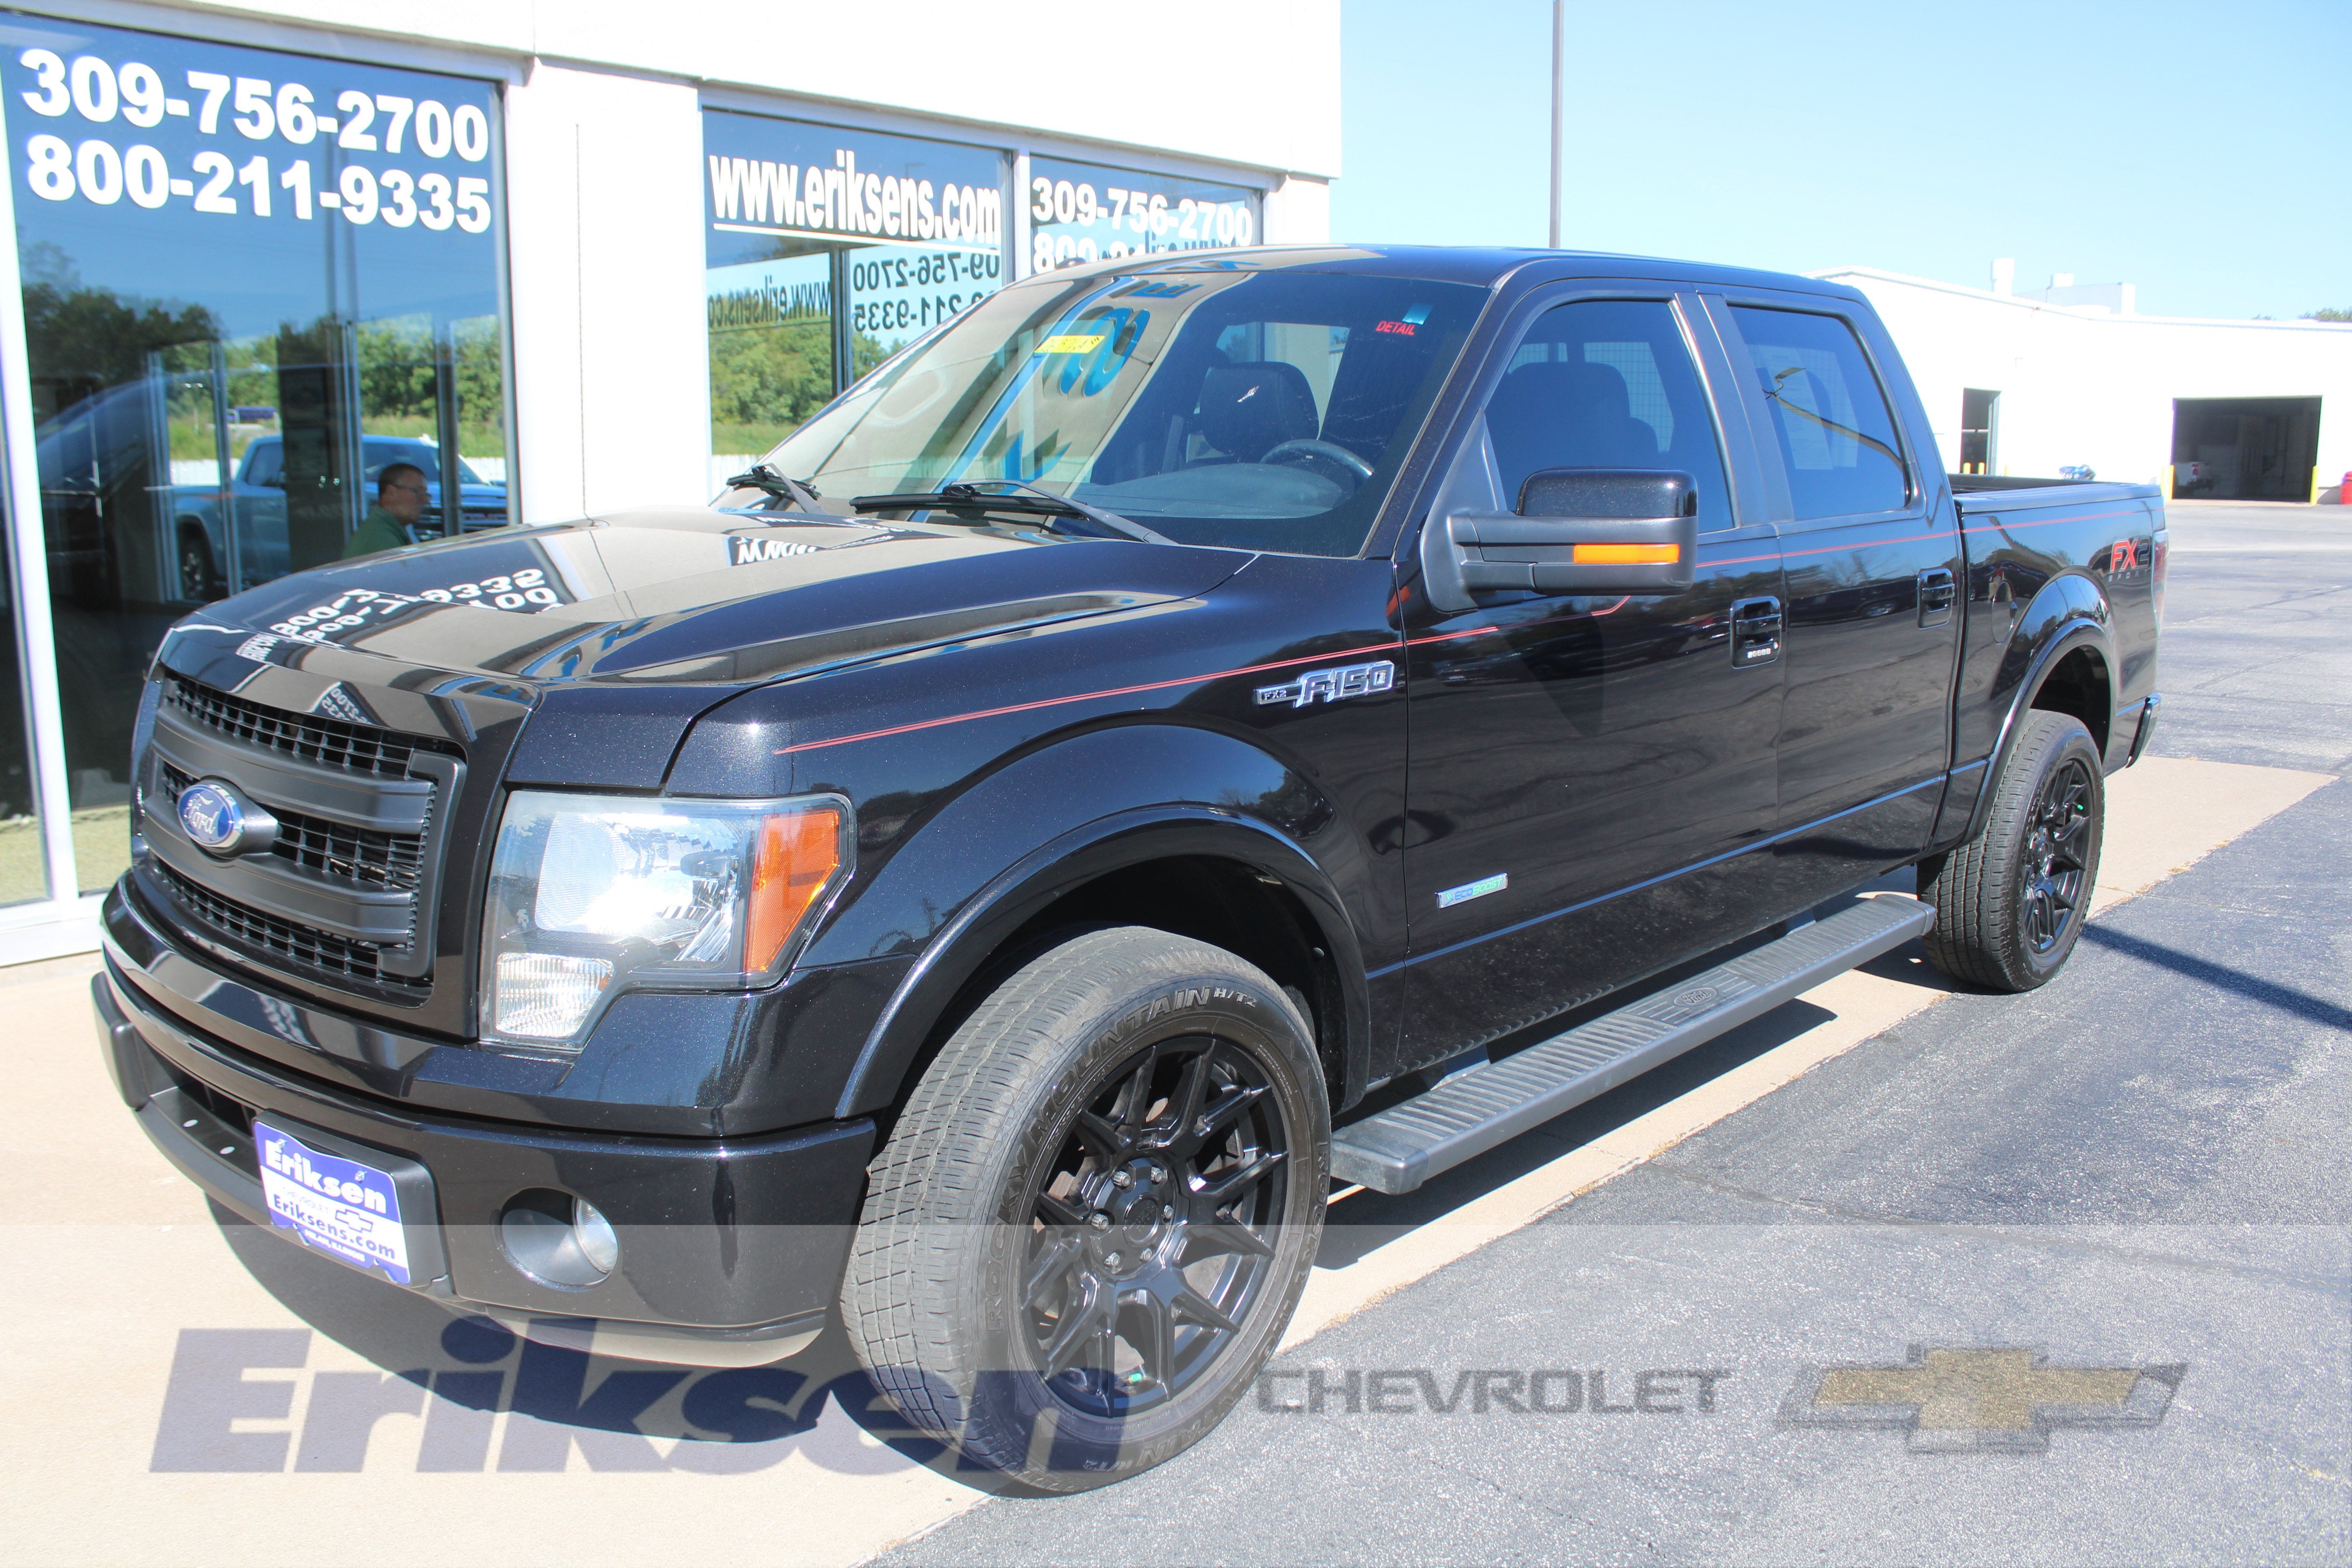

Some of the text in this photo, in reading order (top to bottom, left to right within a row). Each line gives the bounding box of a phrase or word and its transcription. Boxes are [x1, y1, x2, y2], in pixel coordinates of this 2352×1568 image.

[20, 48, 489, 162] 309-756-2700
[27, 134, 492, 234] 800-211-9335
[709, 149, 1001, 245] www.eriksens.com
[1032, 177, 1253, 246] 309-756-2700
[1375, 321, 1416, 335] DETAIL
[2109, 537, 2151, 573] FX2
[1263, 689, 1287, 700] FX2
[183, 793, 220, 834] Ford
[1680, 991, 1711, 1004] Ford
[1027, 987, 1210, 1147] MOUNTAIN
[1214, 987, 1258, 1008] H/T2
[265, 1140, 386, 1214] Eriksen
[273, 1194, 395, 1259] Eriksens.com
